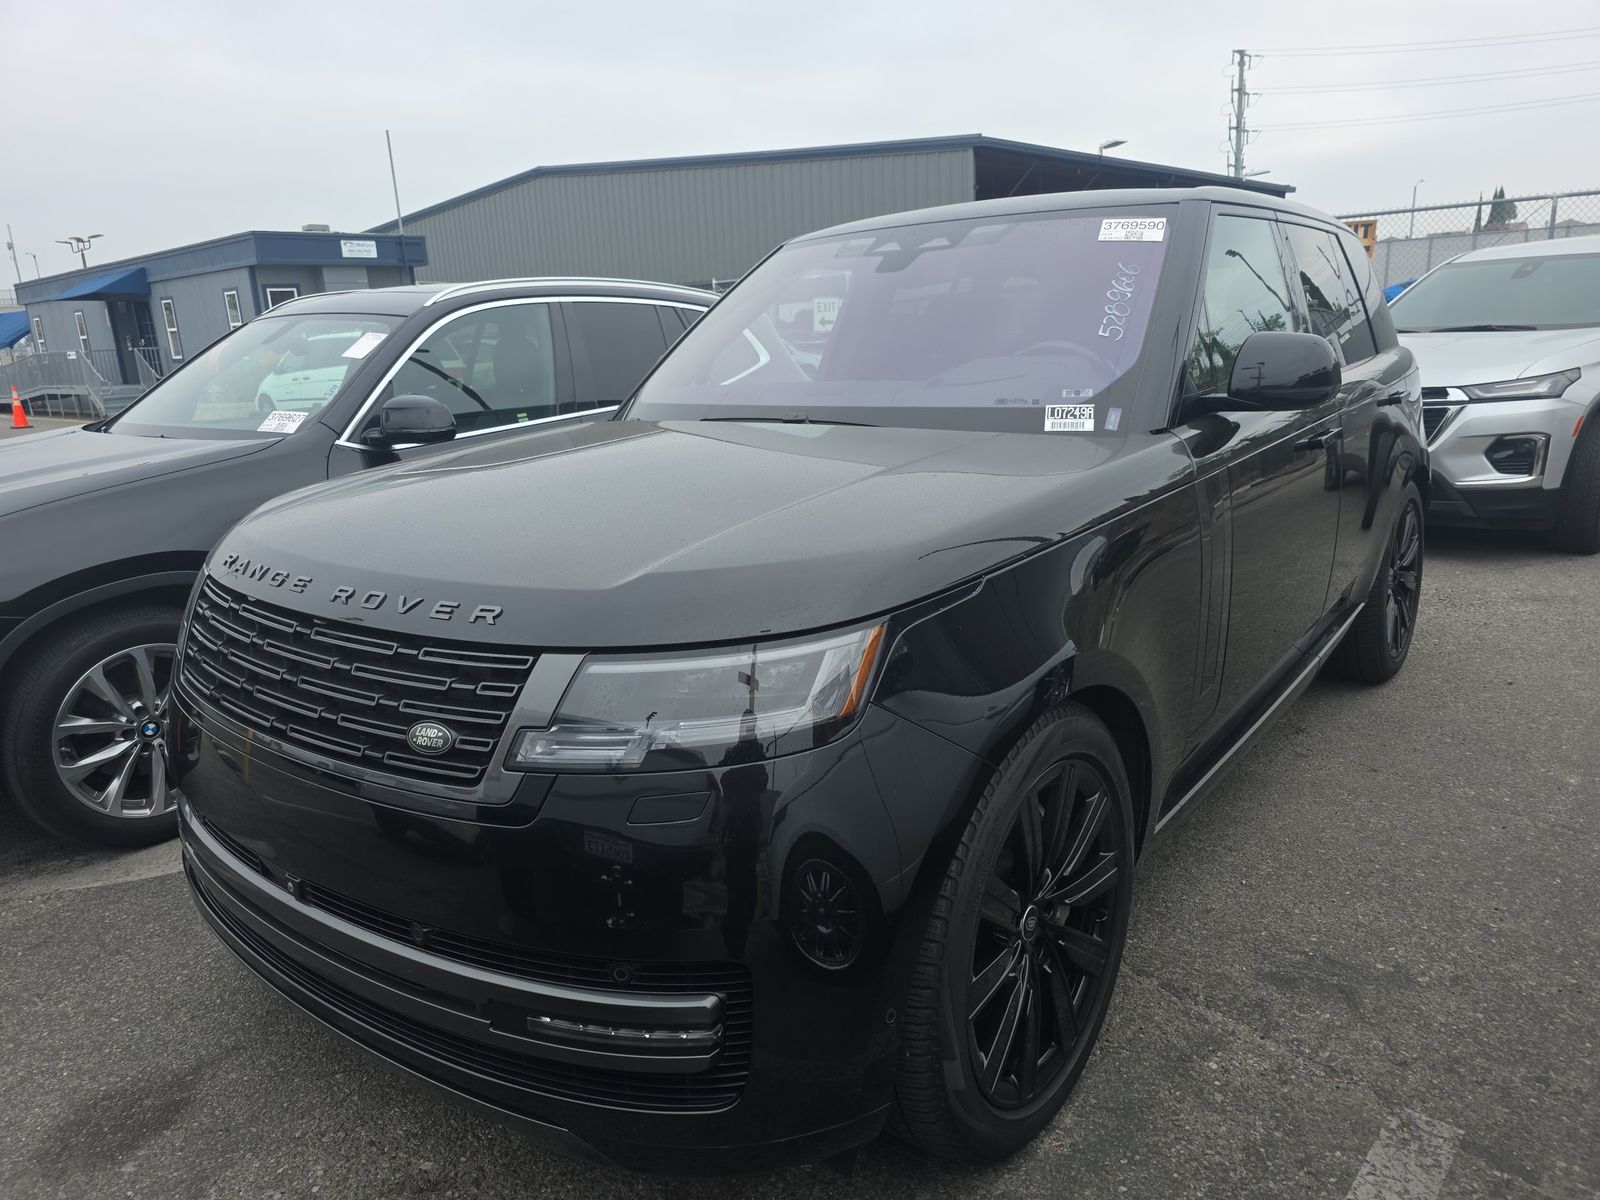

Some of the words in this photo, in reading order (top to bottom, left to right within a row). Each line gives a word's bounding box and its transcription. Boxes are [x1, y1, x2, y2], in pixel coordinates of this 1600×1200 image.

[1103, 220, 1165, 231] 3769590
[816, 301, 837, 313] EXIT
[1047, 407, 1094, 419] L07249A
[222, 552, 313, 594] RANGE
[329, 585, 504, 625] ROVER
[415, 727, 438, 738] LAND
[416, 736, 444, 748] ROVER
